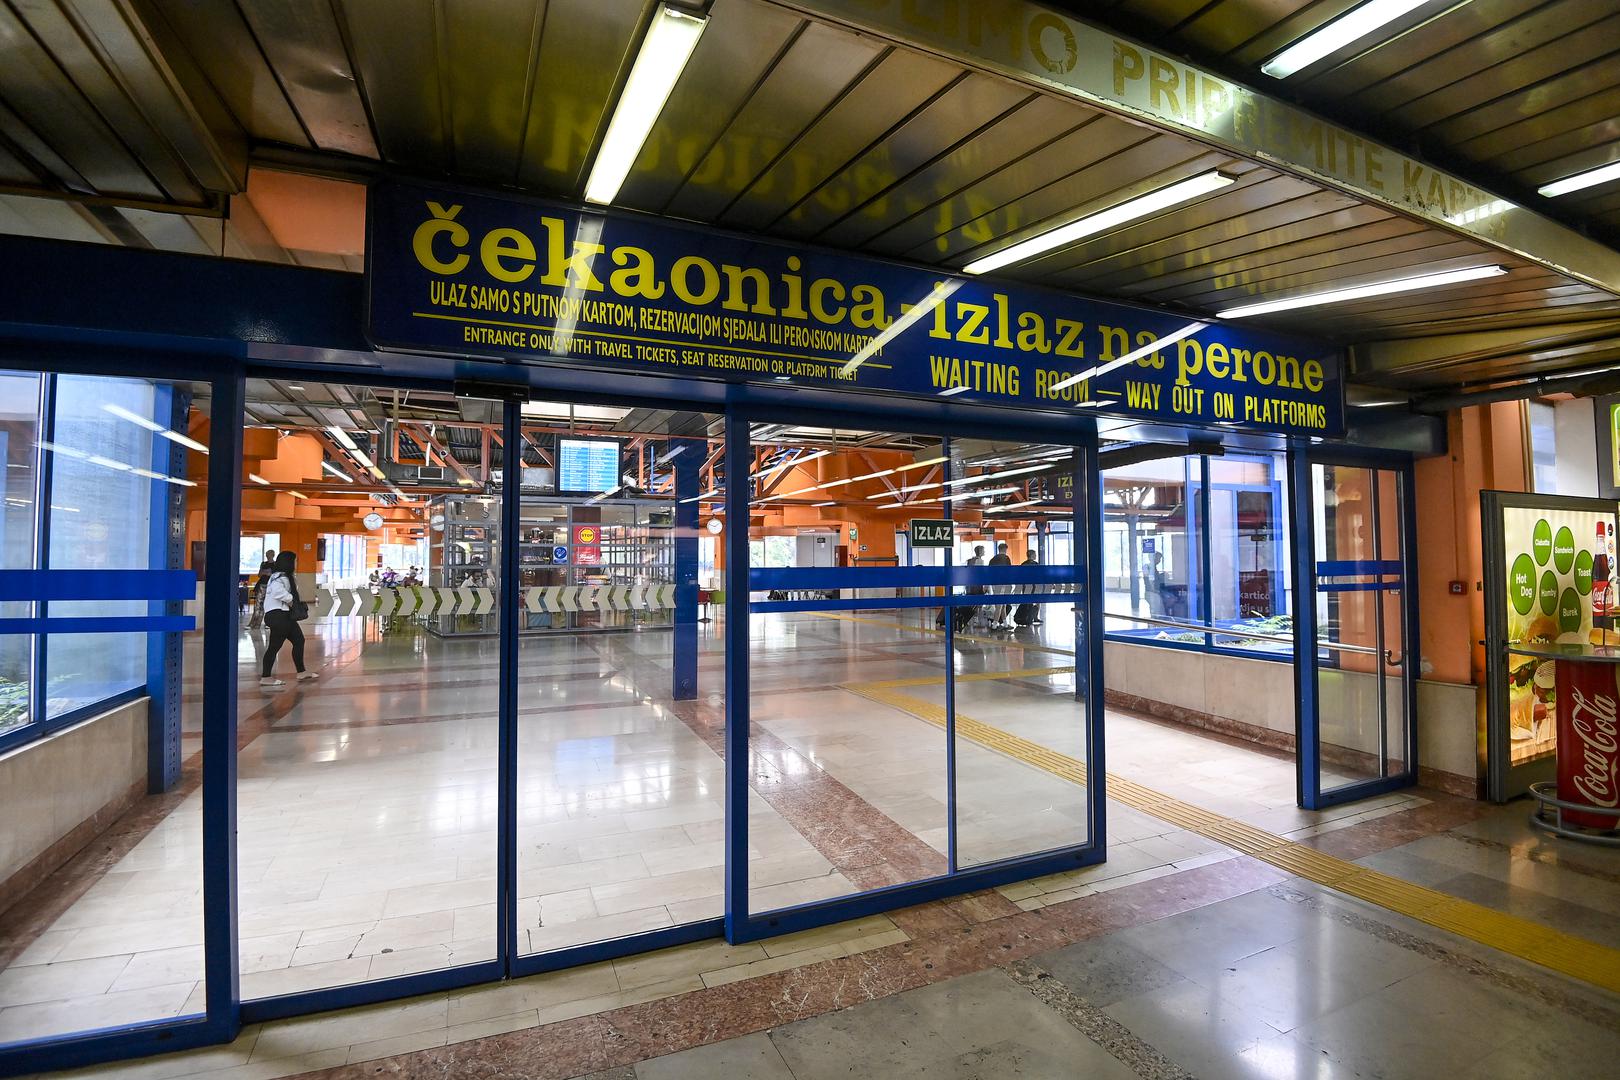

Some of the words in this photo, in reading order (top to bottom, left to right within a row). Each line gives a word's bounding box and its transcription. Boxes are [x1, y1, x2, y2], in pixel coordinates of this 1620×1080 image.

[849, 0, 1078, 74] LIMO
[412, 201, 893, 331] čekaonica
[929, 281, 1084, 358] izlaz
[1098, 325, 1165, 370] na
[1175, 338, 1324, 392] perone
[430, 280, 467, 308] ULAZ
[470, 285, 510, 313] SAMO
[512, 290, 521, 314] S
[524, 292, 579, 321] PUTNOM
[582, 300, 637, 332] KARTOM,
[640, 307, 721, 341] REZERVACIJOM
[723, 319, 766, 344] SJEDALA
[770, 323, 782, 345] ILI
[464, 326, 526, 348] ENTRANCE
[530, 333, 559, 351] ONLY
[562, 335, 592, 354] WITH
[595, 340, 633, 359] TRAVEL
[636, 345, 679, 366] TICKETS,
[682, 350, 704, 366] SEAT
[708, 353, 769, 372] RESERVATION
[771, 360, 784, 374] OR
[930, 355, 1020, 396] WAITING
[1035, 368, 1089, 402] ROOM
[1126, 380, 1161, 411] WAY
[1172, 385, 1204, 415] OUT
[1213, 392, 1235, 419] ON
[1245, 395, 1326, 429] PLATFORMS
[914, 526, 951, 540] IZLAZ
[1515, 573, 1527, 585] Hot
[1521, 586, 1532, 598] Dog
[1578, 568, 1591, 577] Toast
[1562, 608, 1578, 617] Burek
[1572, 685, 1619, 808] Coca-Cola
